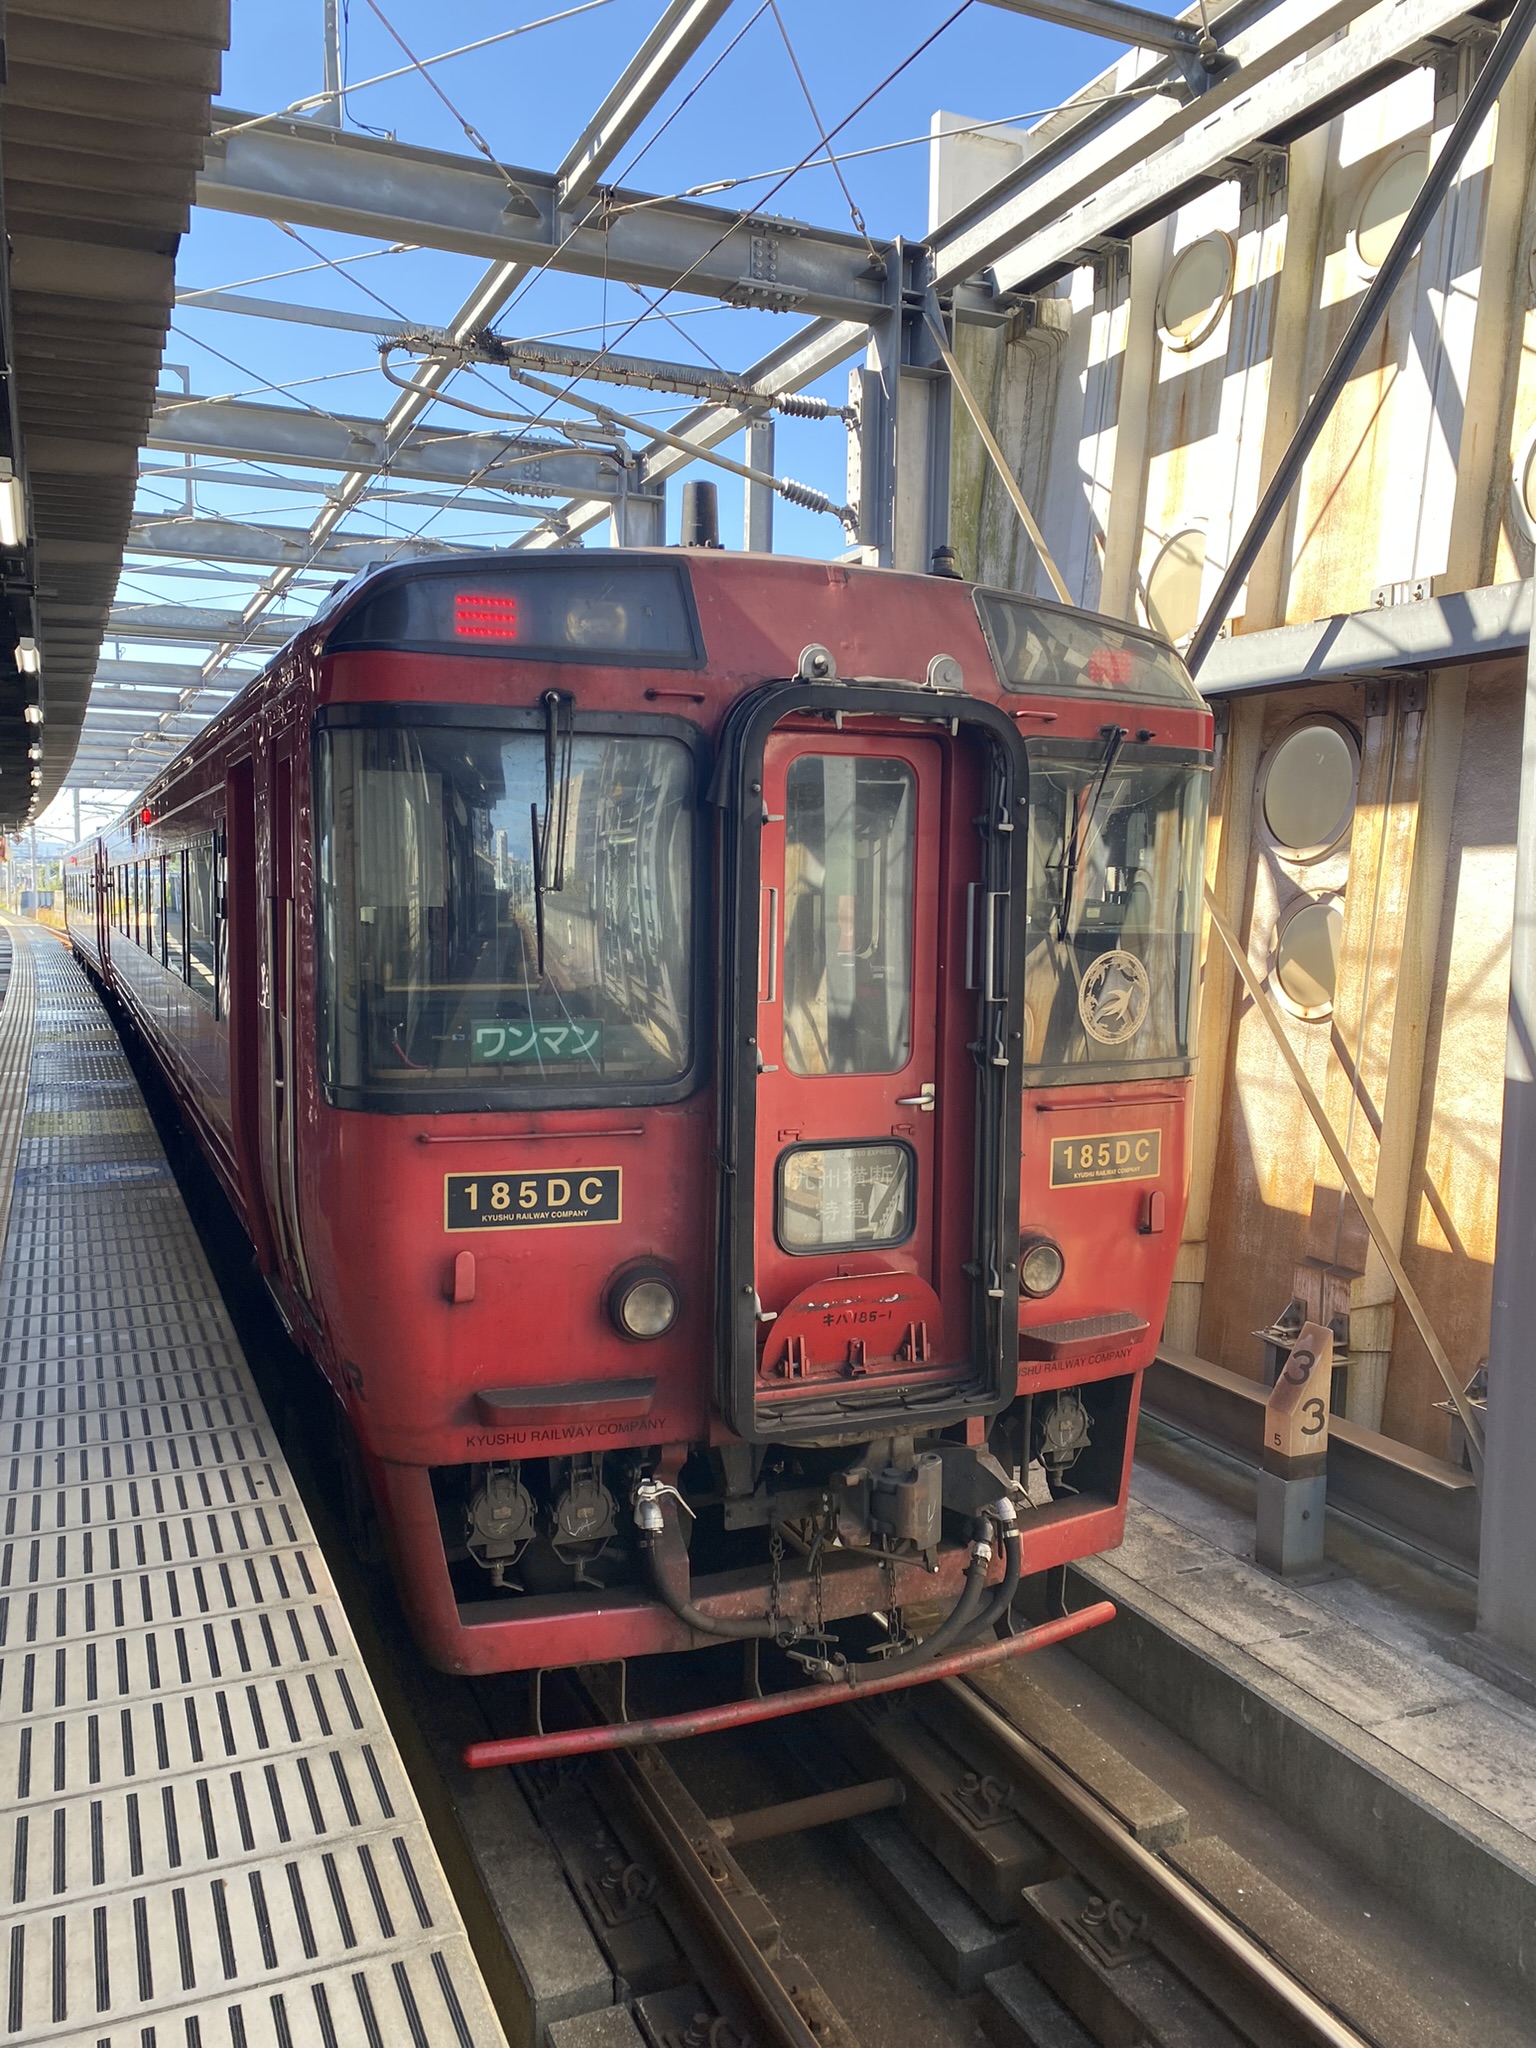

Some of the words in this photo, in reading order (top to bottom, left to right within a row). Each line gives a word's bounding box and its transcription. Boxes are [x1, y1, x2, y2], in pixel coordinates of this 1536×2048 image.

[476, 1027, 599, 1057] ワンマン
[867, 1148, 896, 1156] EXPRESS
[1064, 1138, 1150, 1169] 185DC
[464, 1177, 603, 1210] 185DC
[481, 1213, 515, 1222] KYUSHU
[516, 1211, 550, 1221] RAILWAY
[551, 1209, 588, 1219] COMPANY
[1044, 1357, 1087, 1373] RAILWAY
[1089, 1348, 1133, 1365] COMPANY
[1283, 1350, 1315, 1385] 3
[1300, 1398, 1325, 1435] 3
[466, 1432, 526, 1447] KYUSHU
[531, 1426, 594, 1442] RAILWAY
[597, 1417, 667, 1435] COMPANY
[1273, 1433, 1282, 1446] 5
